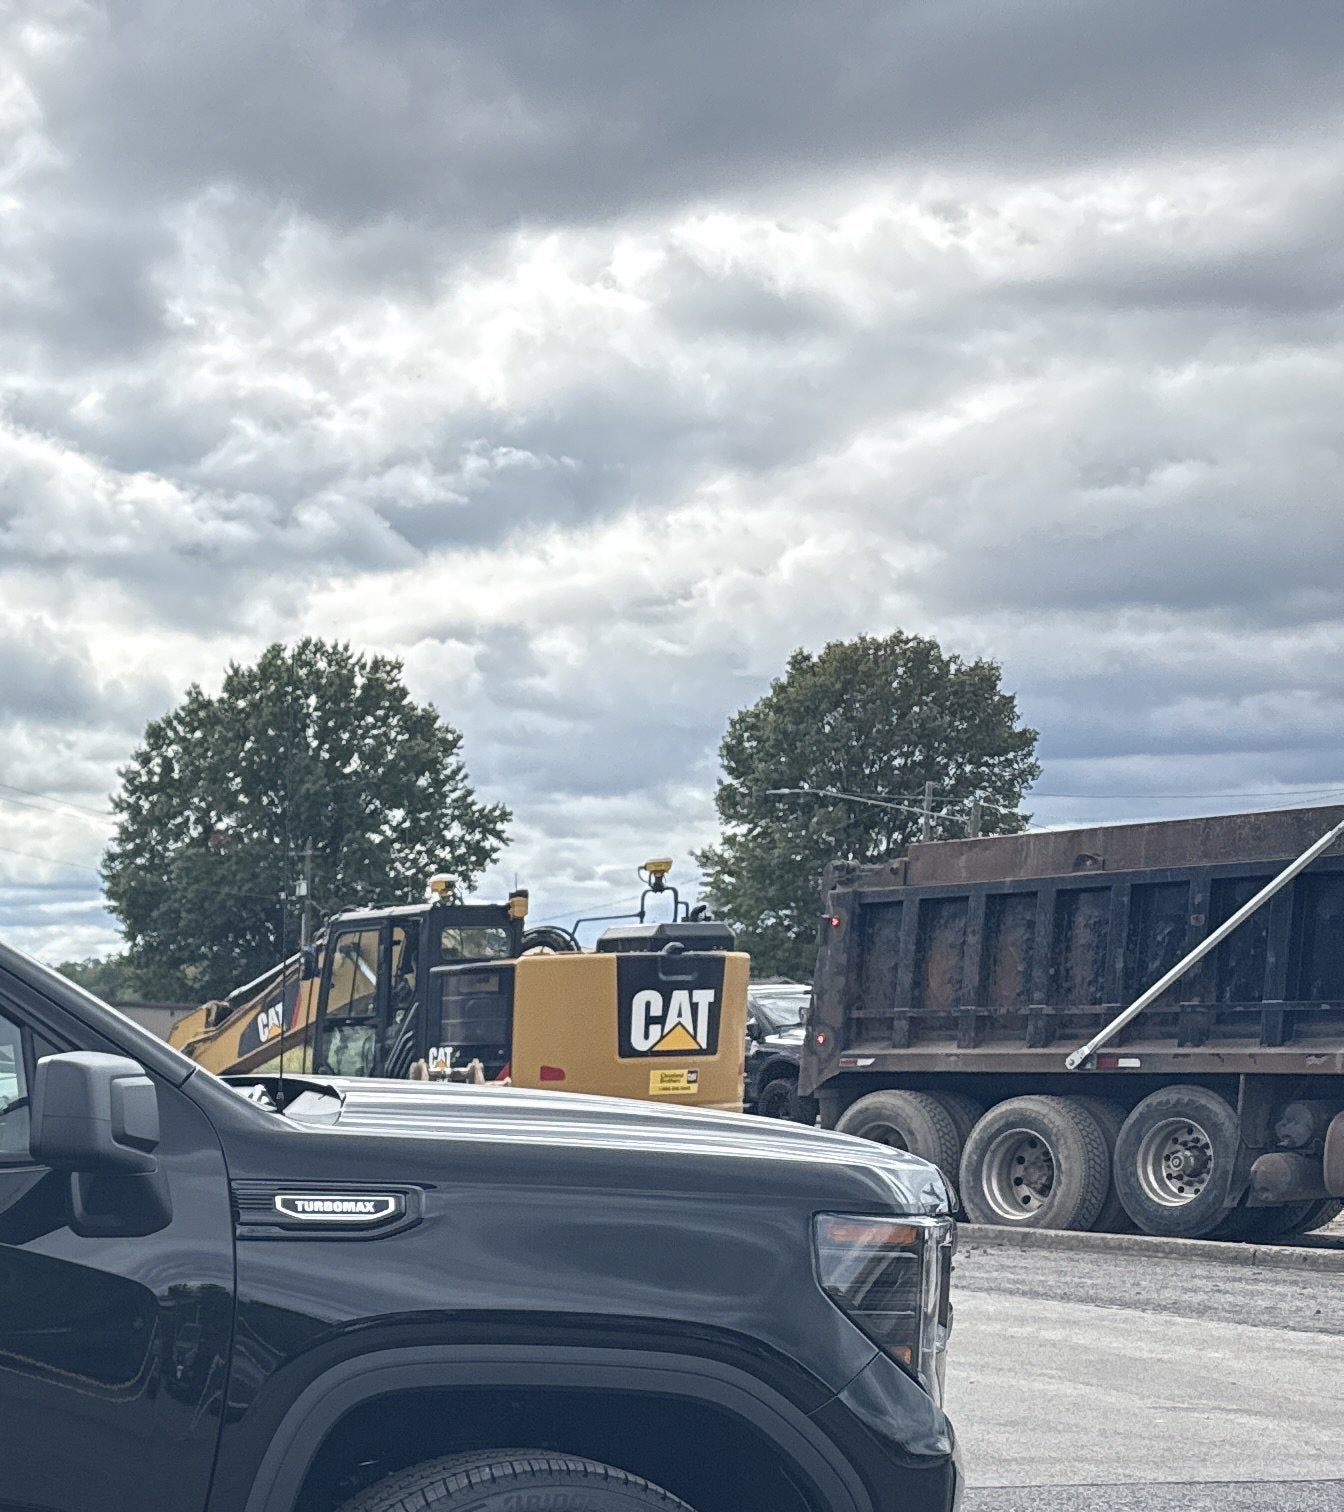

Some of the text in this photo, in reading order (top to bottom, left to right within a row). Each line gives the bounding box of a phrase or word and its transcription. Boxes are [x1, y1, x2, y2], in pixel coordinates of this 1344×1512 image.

[257, 1002, 286, 1042] CAT
[630, 989, 715, 1052] CAT
[428, 1046, 453, 1070] CAT
[294, 1200, 375, 1212] TURBOMAX
